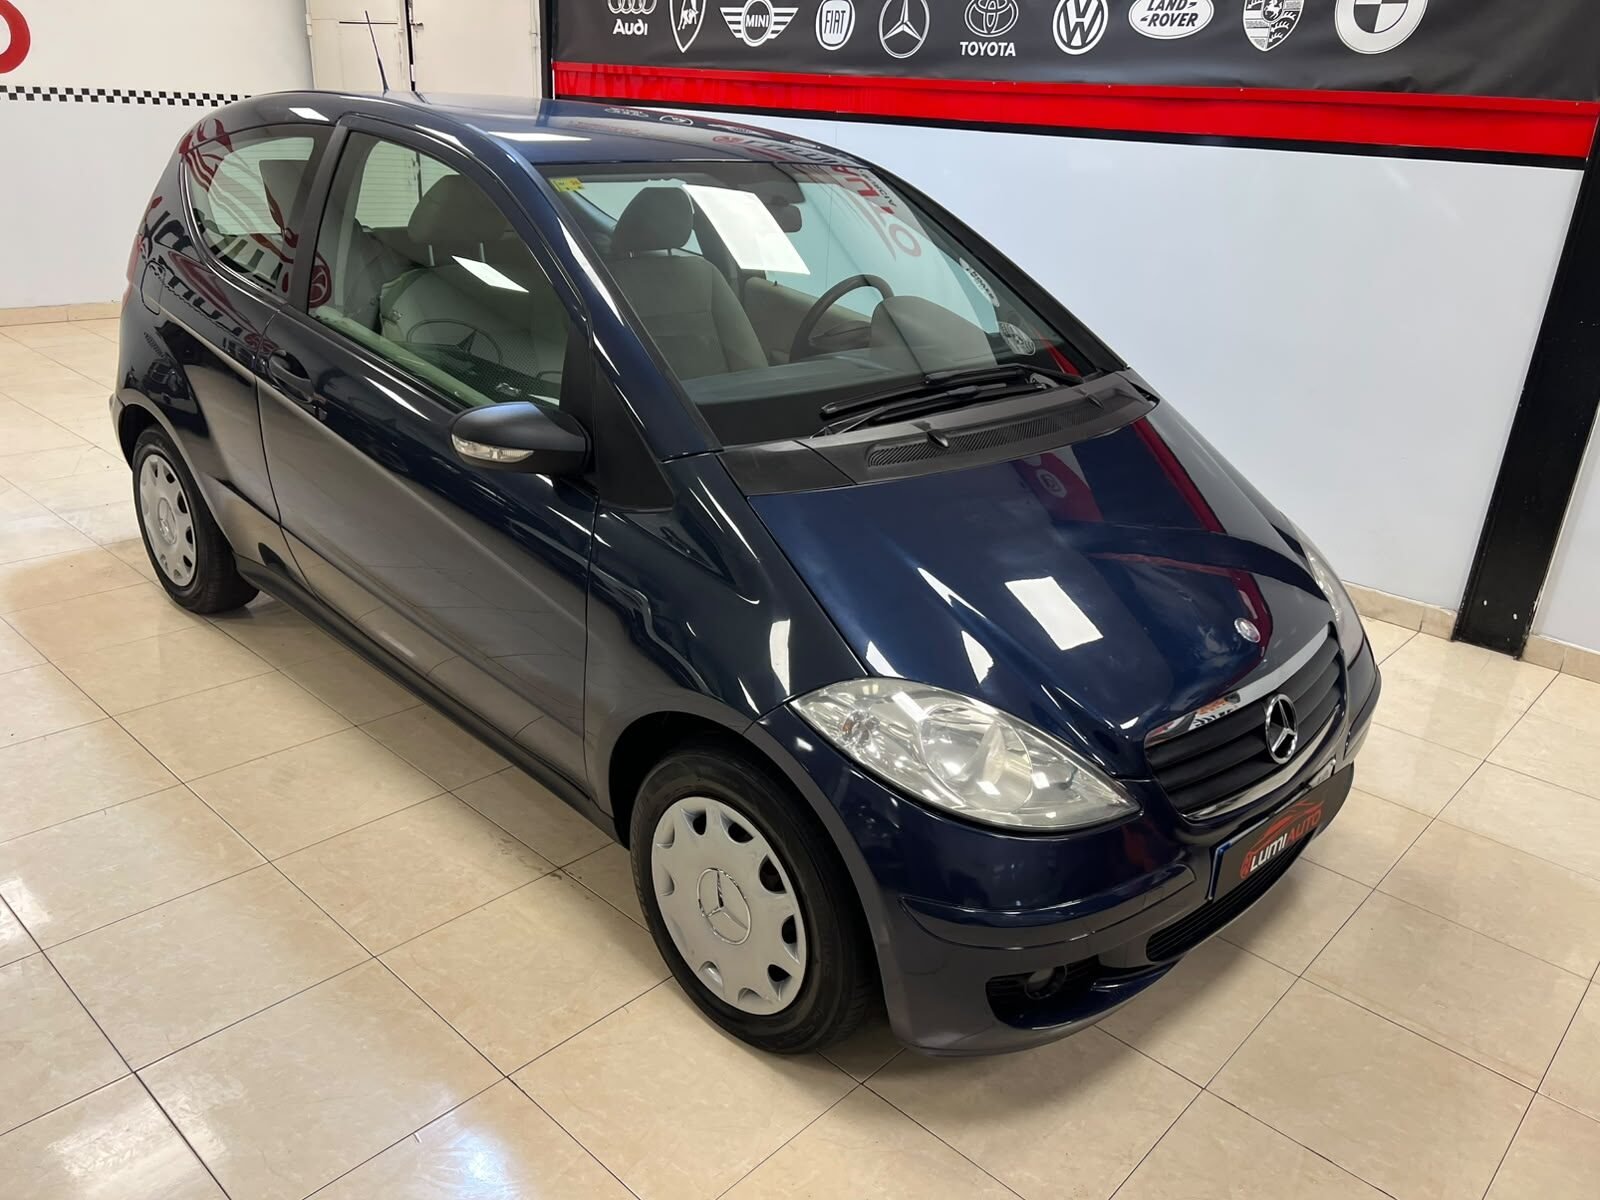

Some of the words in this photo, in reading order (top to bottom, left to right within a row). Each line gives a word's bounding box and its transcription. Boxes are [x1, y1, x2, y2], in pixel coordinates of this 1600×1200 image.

[1147, 0, 1191, 11] LAND
[612, 19, 648, 36] Audi
[745, 14, 770, 28] MINI
[823, 10, 846, 34] FIAT
[1147, 13, 1198, 27] ROVER
[959, 41, 1017, 57] TOYOTA
[1287, 807, 1323, 844] AUTO
